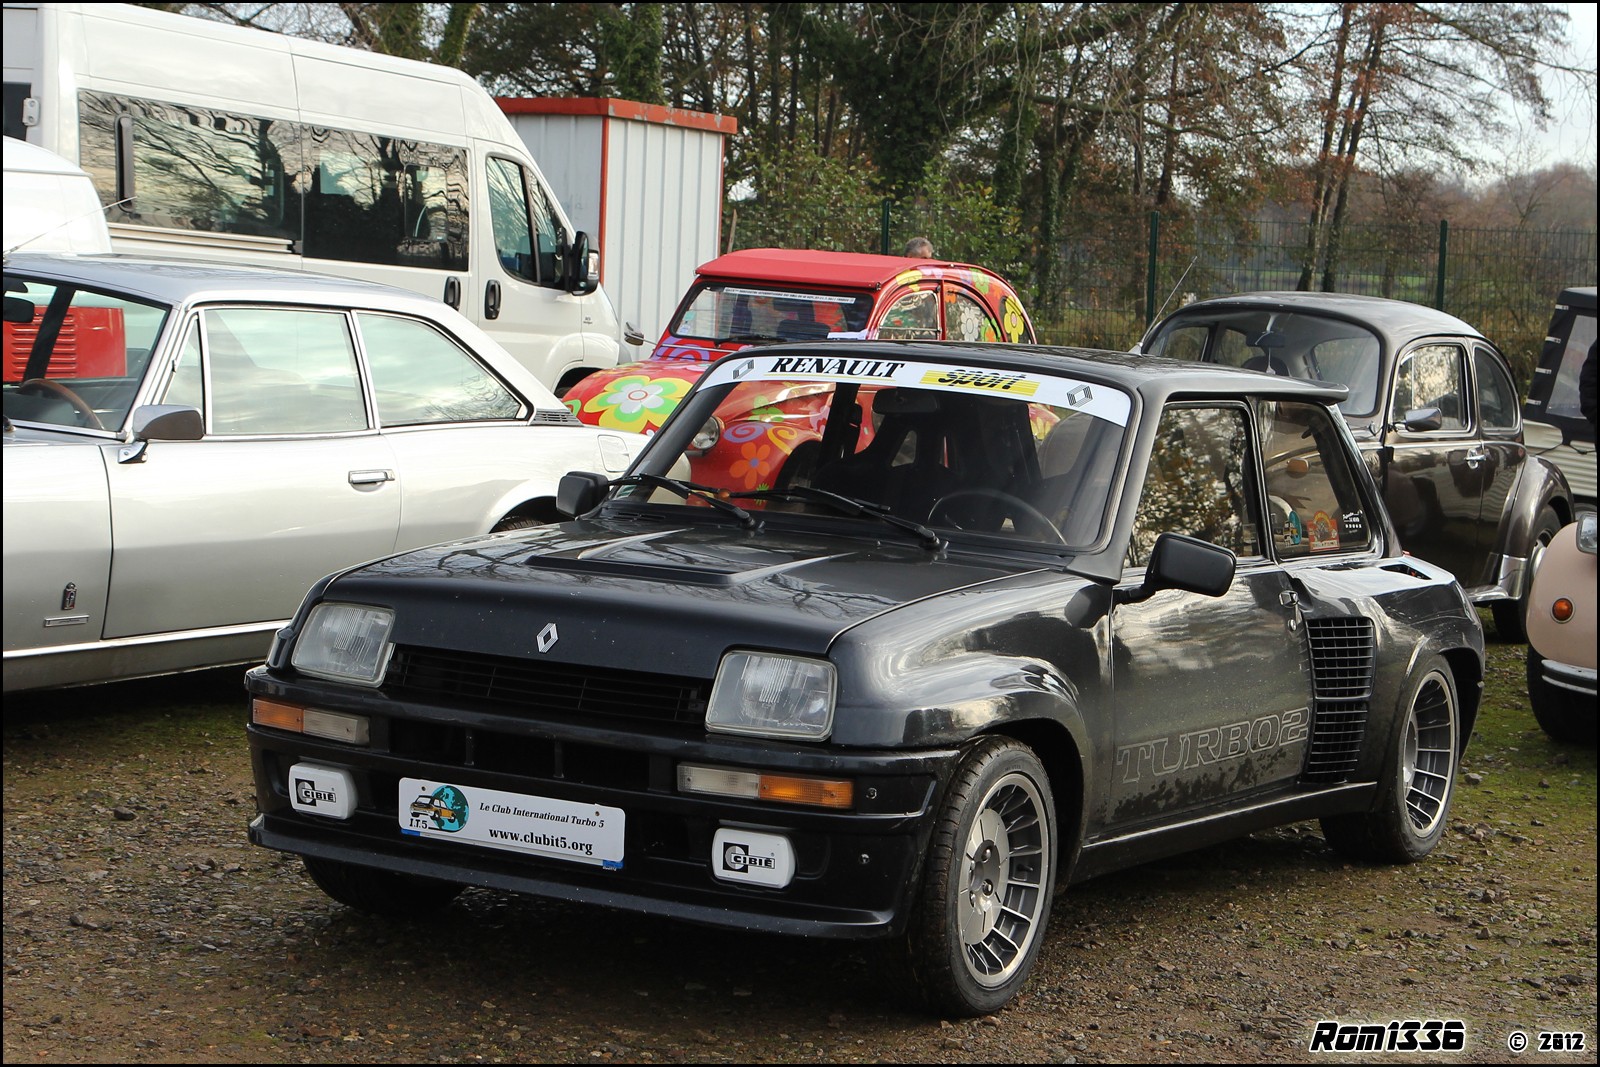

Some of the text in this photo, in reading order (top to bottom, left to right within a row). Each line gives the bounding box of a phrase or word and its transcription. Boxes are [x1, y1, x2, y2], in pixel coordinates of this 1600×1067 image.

[769, 357, 904, 378] RENAULT
[479, 802, 605, 828] Le Club International Turbo 5
[488, 828, 593, 855] www.clubit5.org
